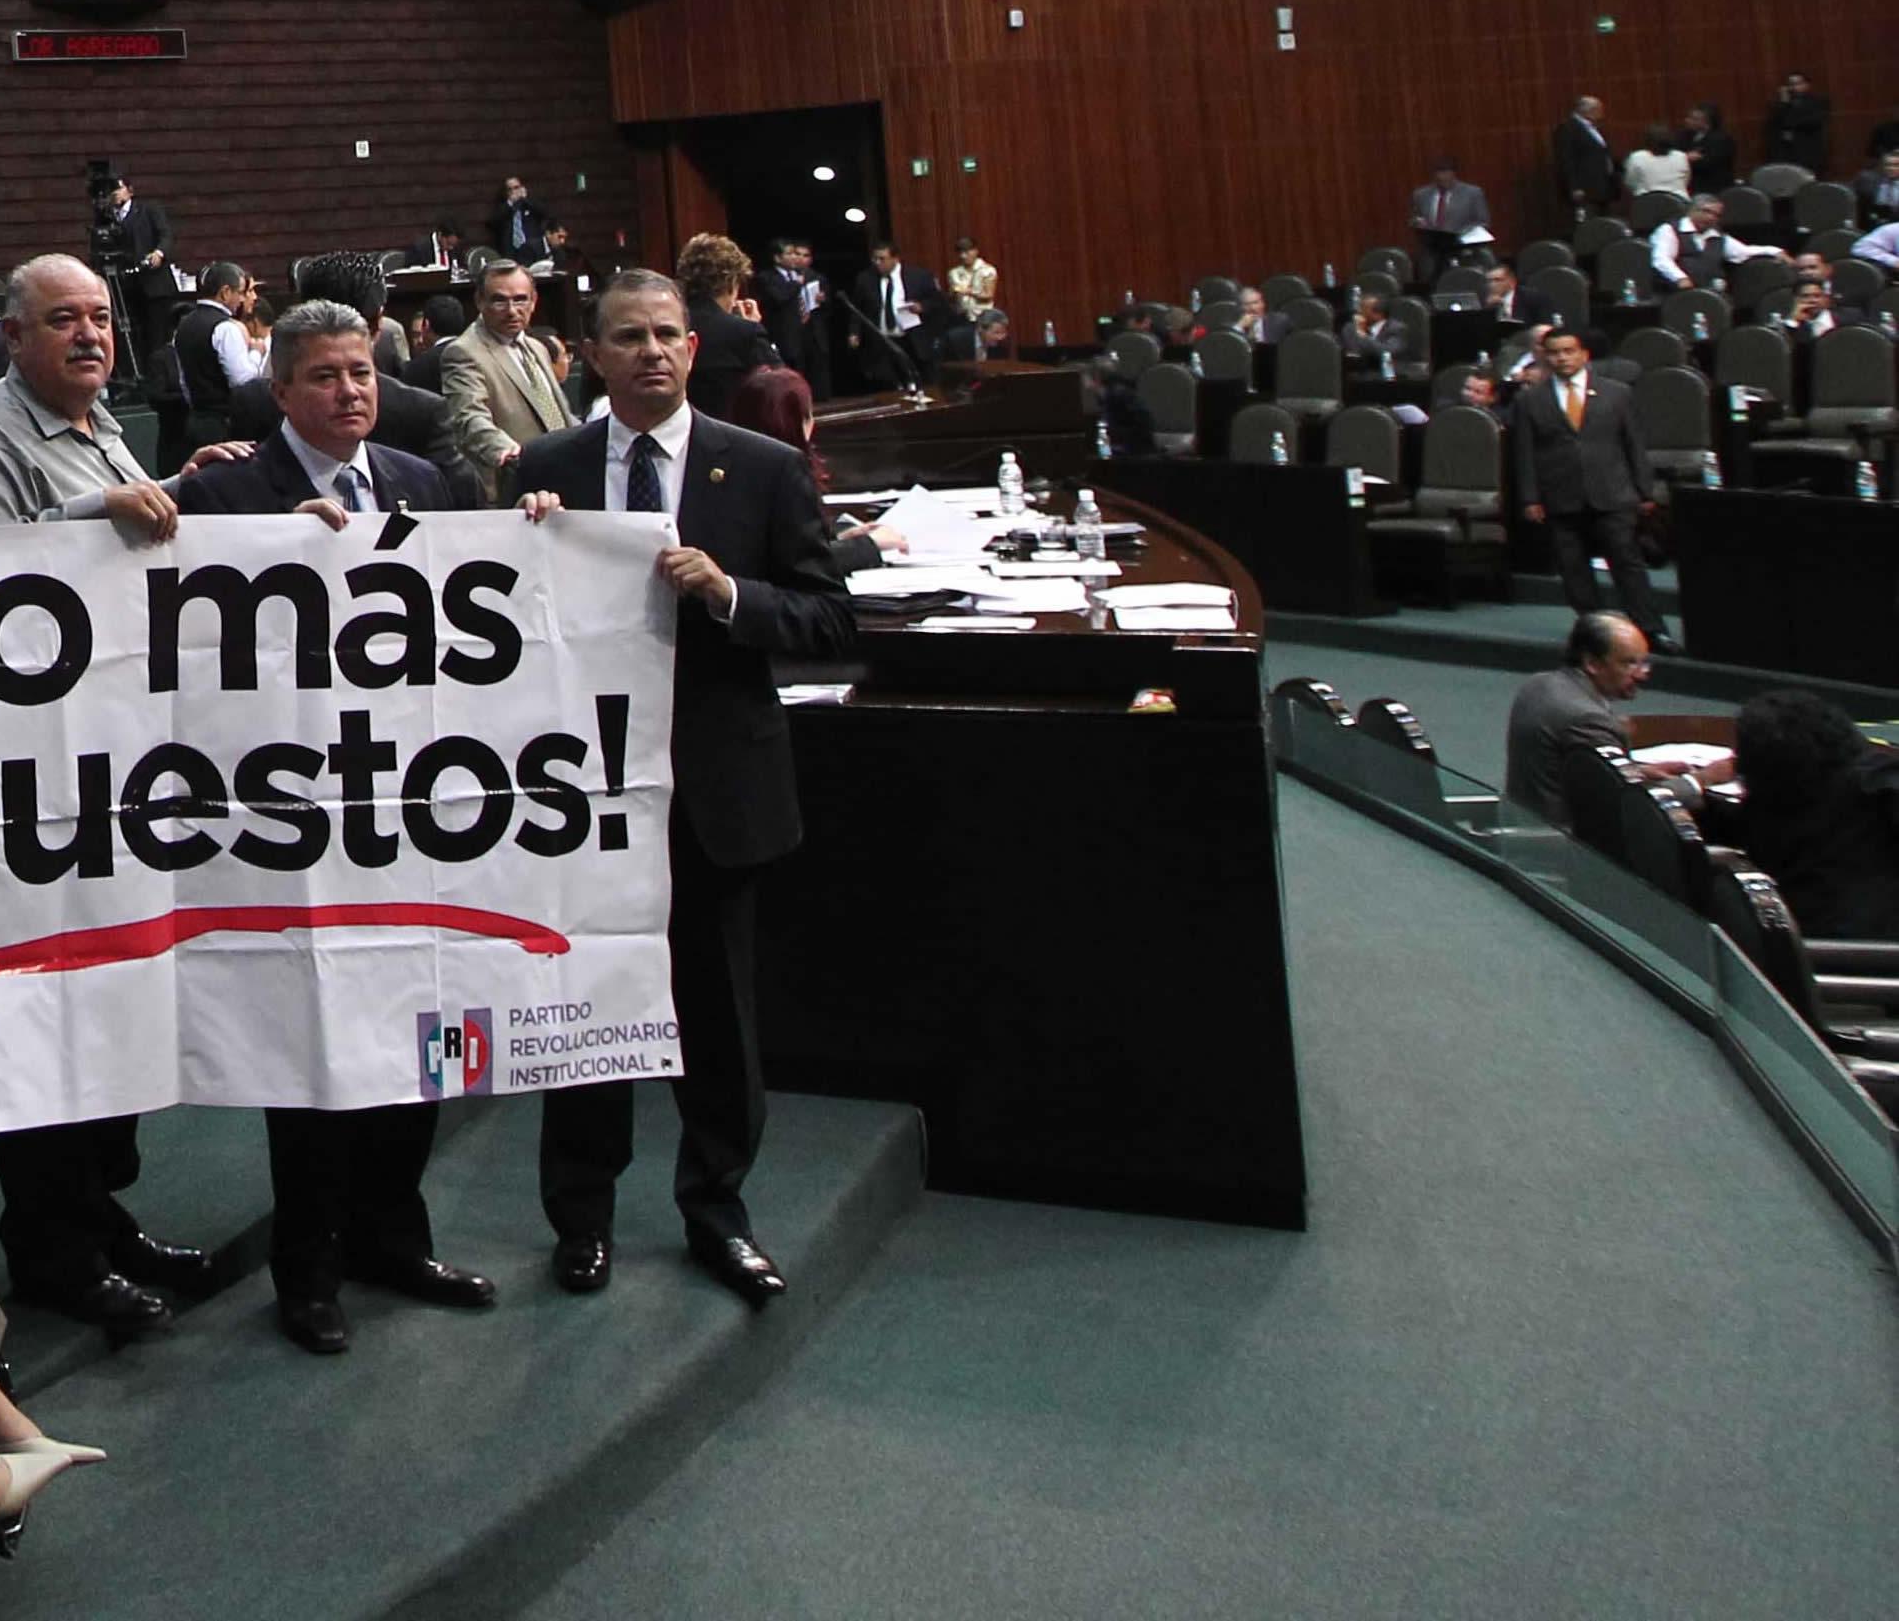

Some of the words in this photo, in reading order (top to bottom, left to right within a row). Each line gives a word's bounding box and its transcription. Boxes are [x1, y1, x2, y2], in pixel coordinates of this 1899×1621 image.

[146, 513, 524, 695] más
[509, 1001, 593, 1028] PARTIDO
[427, 1025, 480, 1075] PRI
[509, 1021, 680, 1058] REVOLUCIONARIO
[509, 1053, 654, 1087] INSTITUCIONAL
